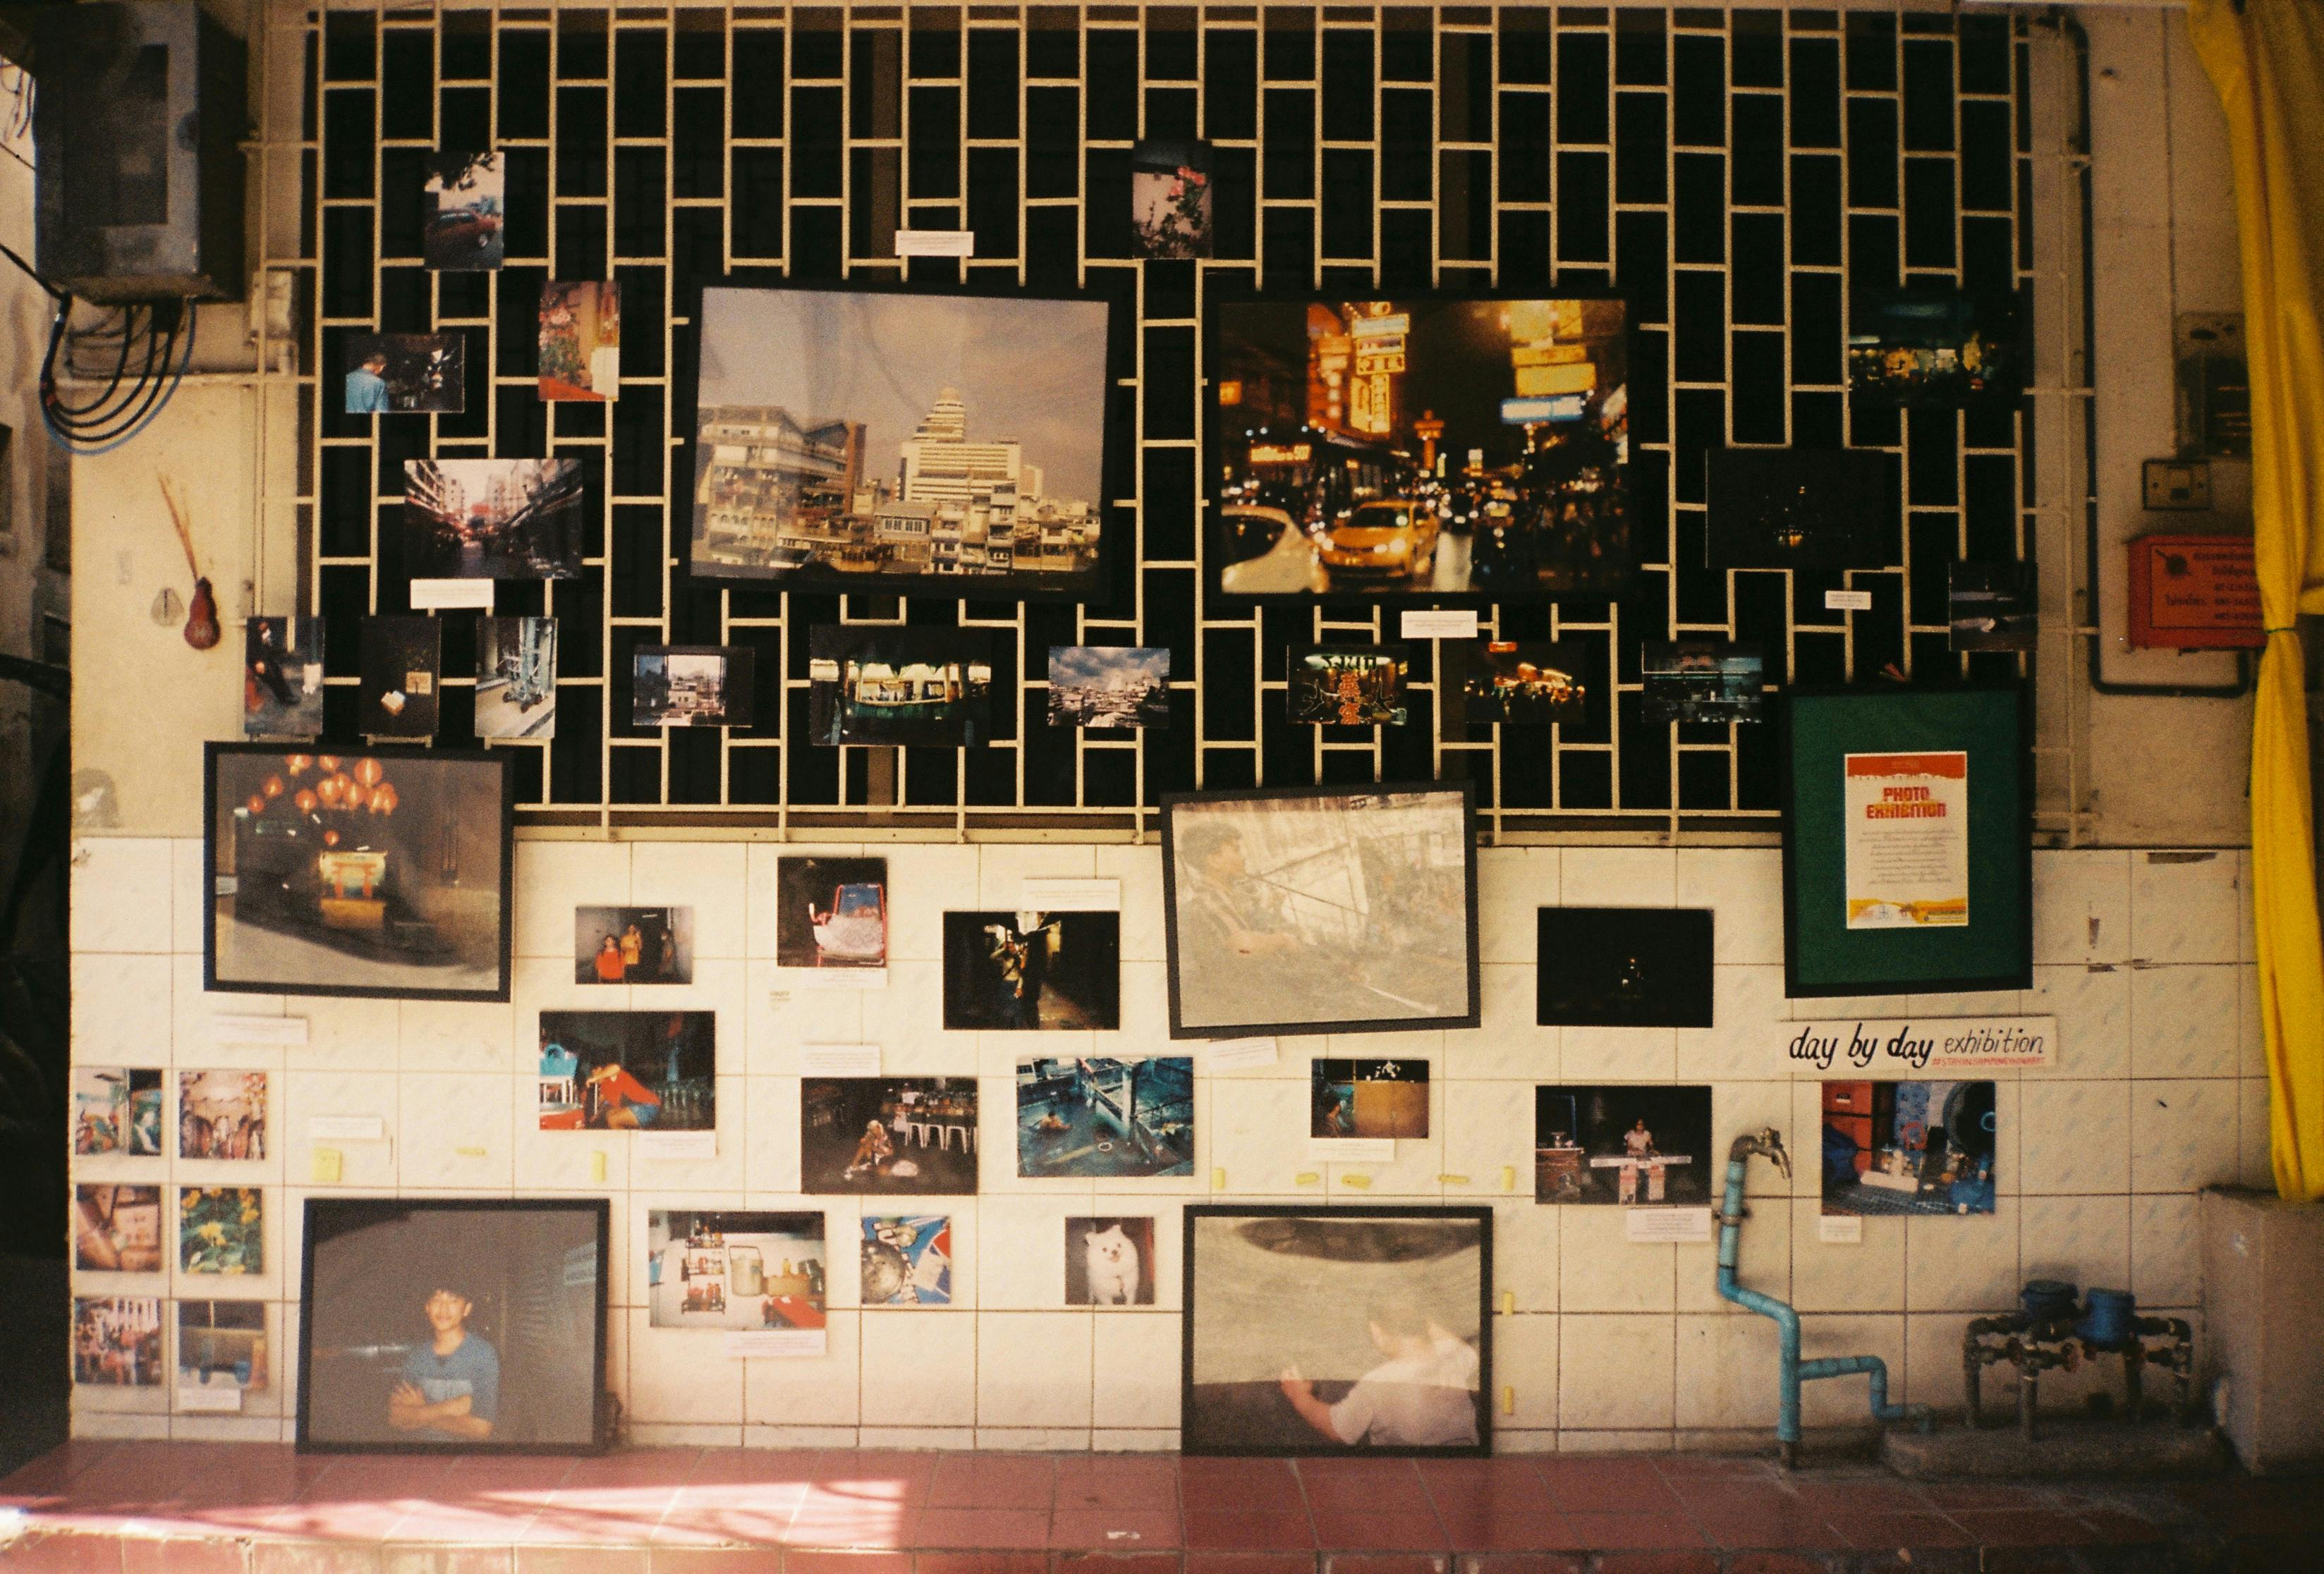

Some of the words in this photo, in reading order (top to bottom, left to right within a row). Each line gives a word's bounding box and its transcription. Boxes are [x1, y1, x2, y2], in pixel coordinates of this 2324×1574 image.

[1883, 786, 1930, 801] PHOTO
[1866, 803, 1946, 819] EXHIBITION
[1789, 1026, 1838, 1070] day
[1847, 1023, 1878, 1068] by
[1887, 1025, 1934, 1069] day
[1945, 1028, 2043, 1054] exhibition
